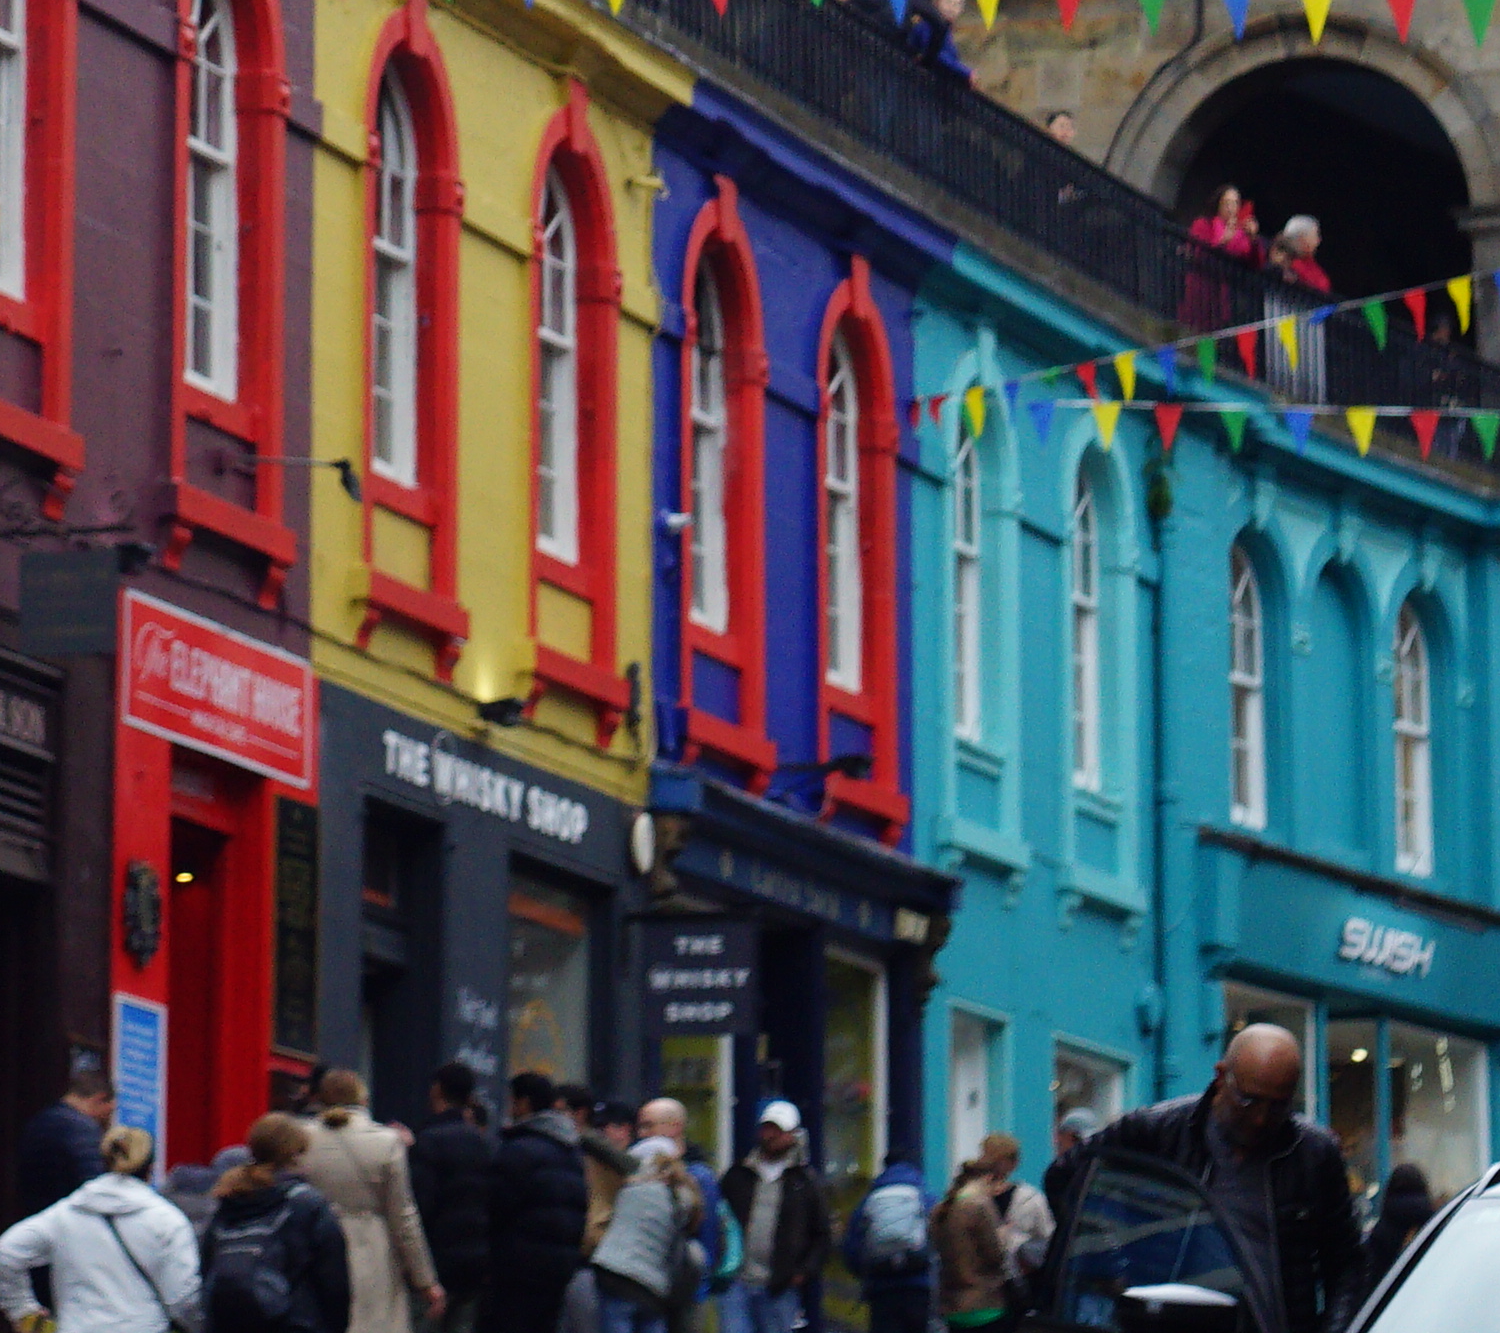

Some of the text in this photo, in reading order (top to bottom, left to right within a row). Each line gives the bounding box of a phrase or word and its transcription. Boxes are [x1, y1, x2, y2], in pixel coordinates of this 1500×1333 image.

[383, 729, 590, 845] THE WHISKY SHOP
[673, 934, 725, 956] THE
[1339, 916, 1437, 979] SWISH
[649, 966, 750, 989] WHISKY
[663, 1001, 735, 1024] SHOP
